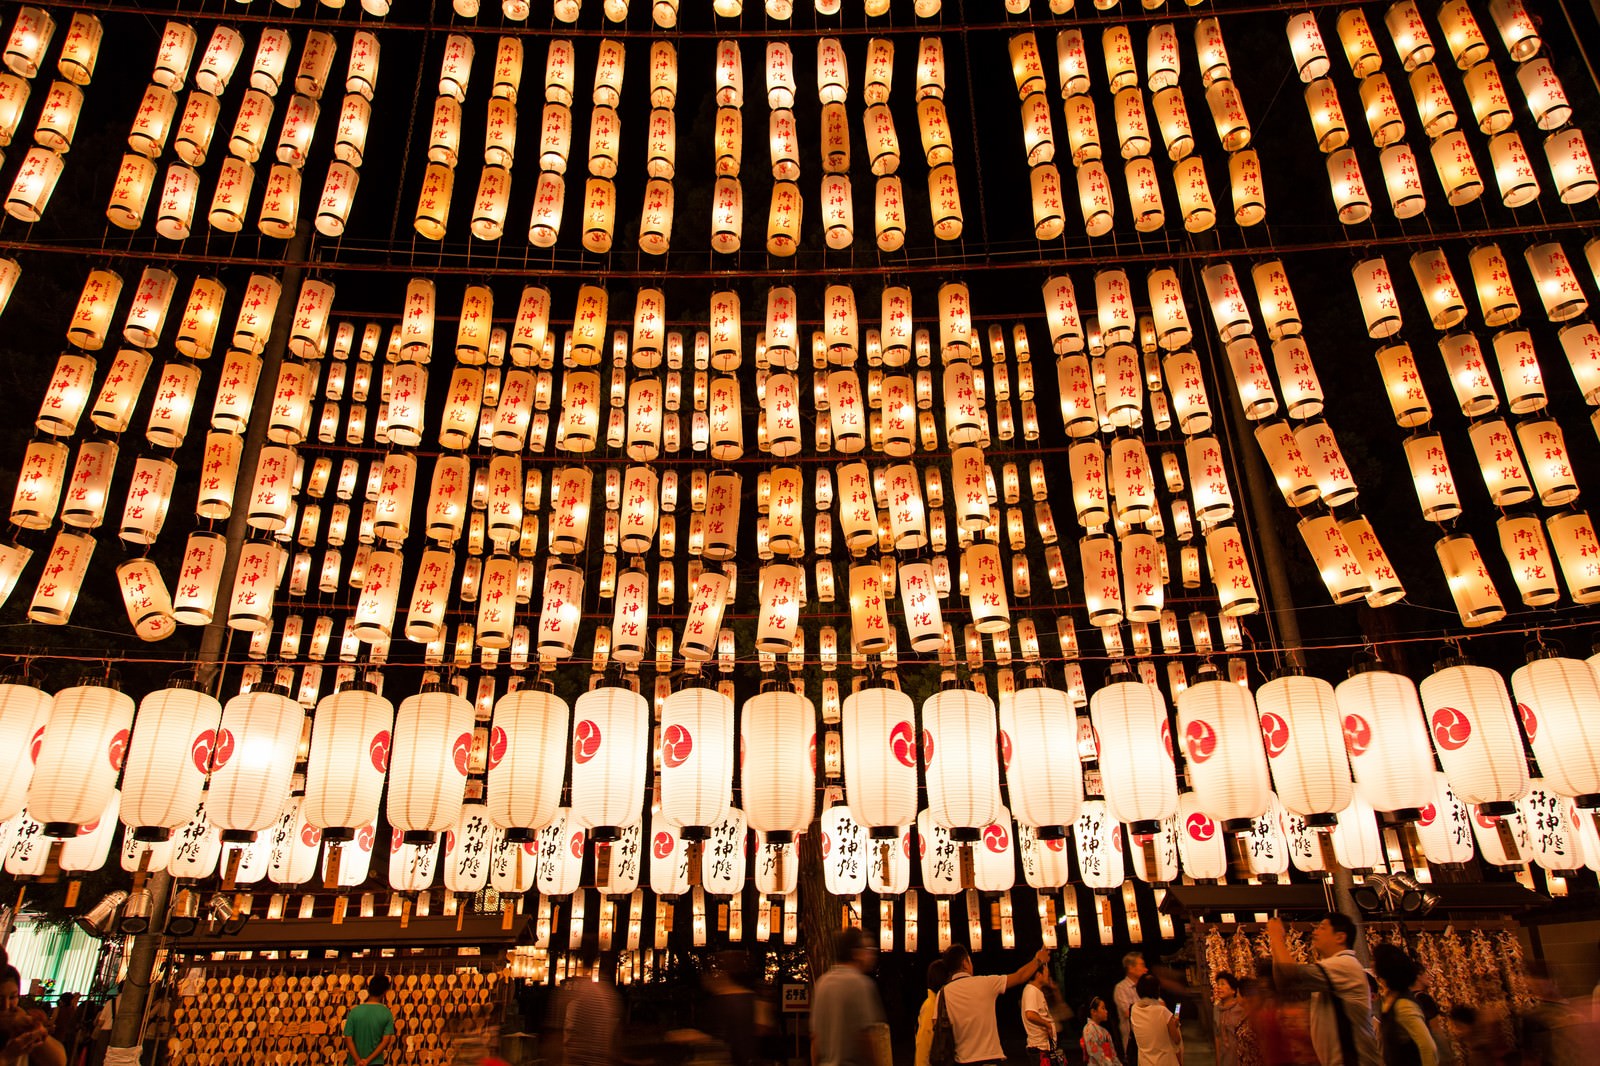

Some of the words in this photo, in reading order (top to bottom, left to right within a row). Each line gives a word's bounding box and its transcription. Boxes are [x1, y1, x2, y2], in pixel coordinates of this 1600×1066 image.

[460, 816, 487, 878] 御神燈
[713, 820, 735, 880] 御神燈
[837, 818, 858, 880] 御神燈
[1080, 815, 1100, 876] 御神燈
[1251, 815, 1273, 859] 神燈
[1290, 813, 1312, 857] 神燈
[1530, 791, 1564, 855] 御神燈
